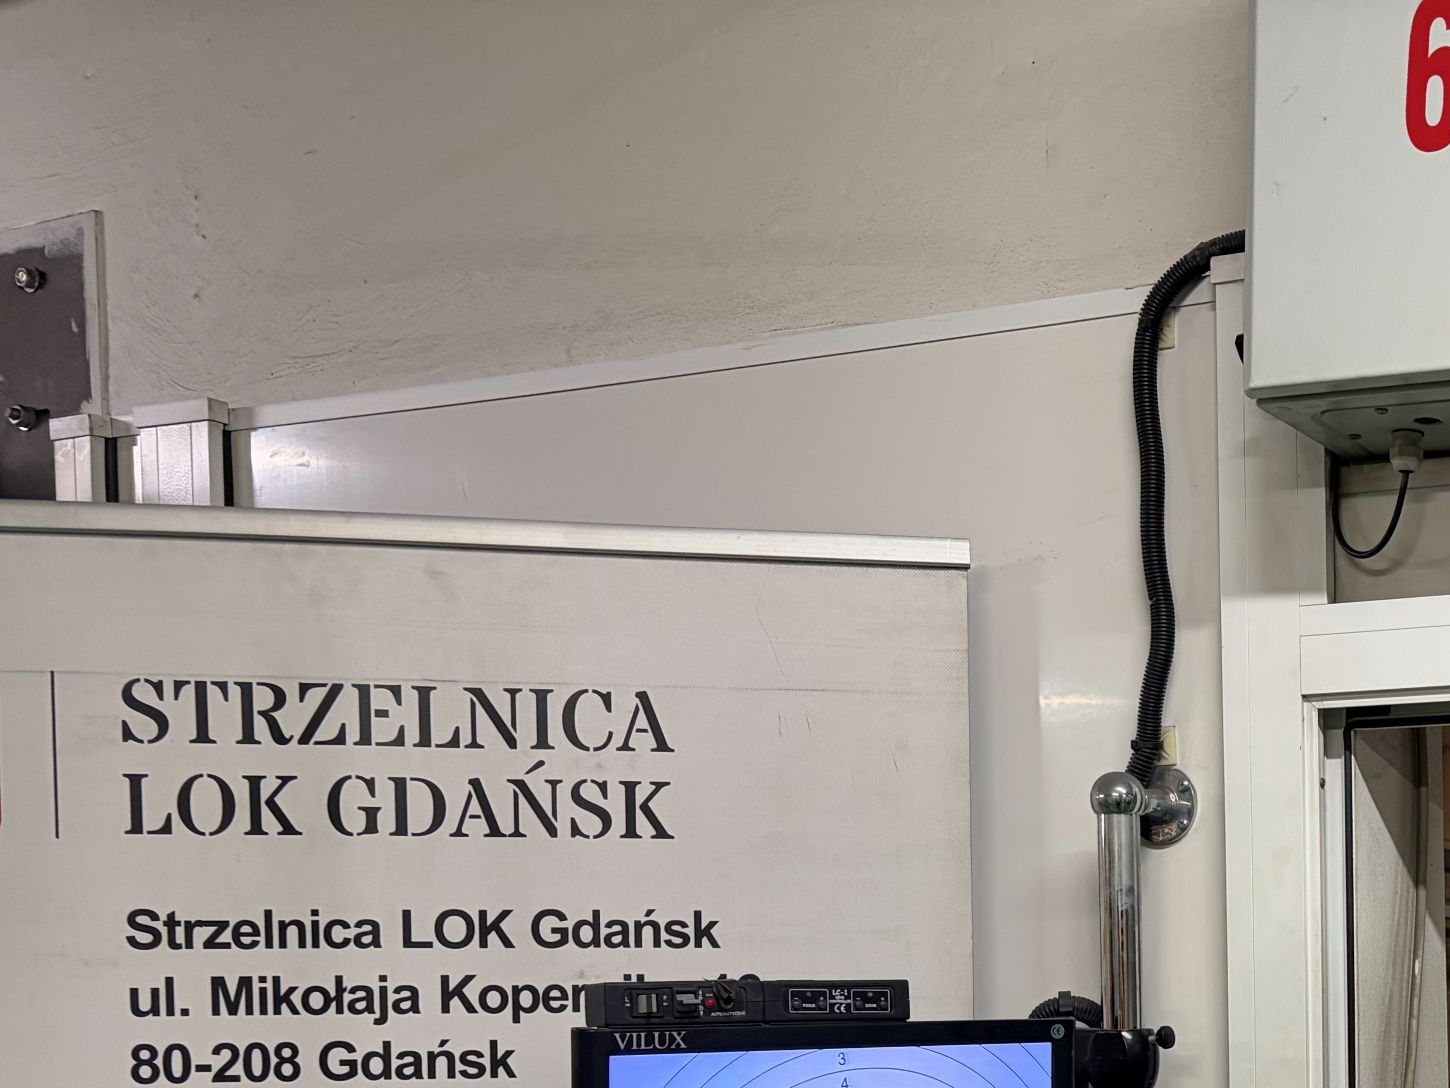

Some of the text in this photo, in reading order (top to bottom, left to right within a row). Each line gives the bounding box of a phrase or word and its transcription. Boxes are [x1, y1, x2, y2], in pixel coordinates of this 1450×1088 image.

[120, 678, 675, 754] STRZELNICA
[123, 760, 675, 841] LOK GDAŃSK
[126, 908, 720, 952] Strzelnica LOK Gdańsk
[129, 977, 190, 1018] ul.
[211, 974, 421, 1027] Mikołaja
[130, 1038, 517, 1085] 80-208 Gdańsk
[613, 1031, 688, 1050] VILUX
[838, 1052, 847, 1065] 3
